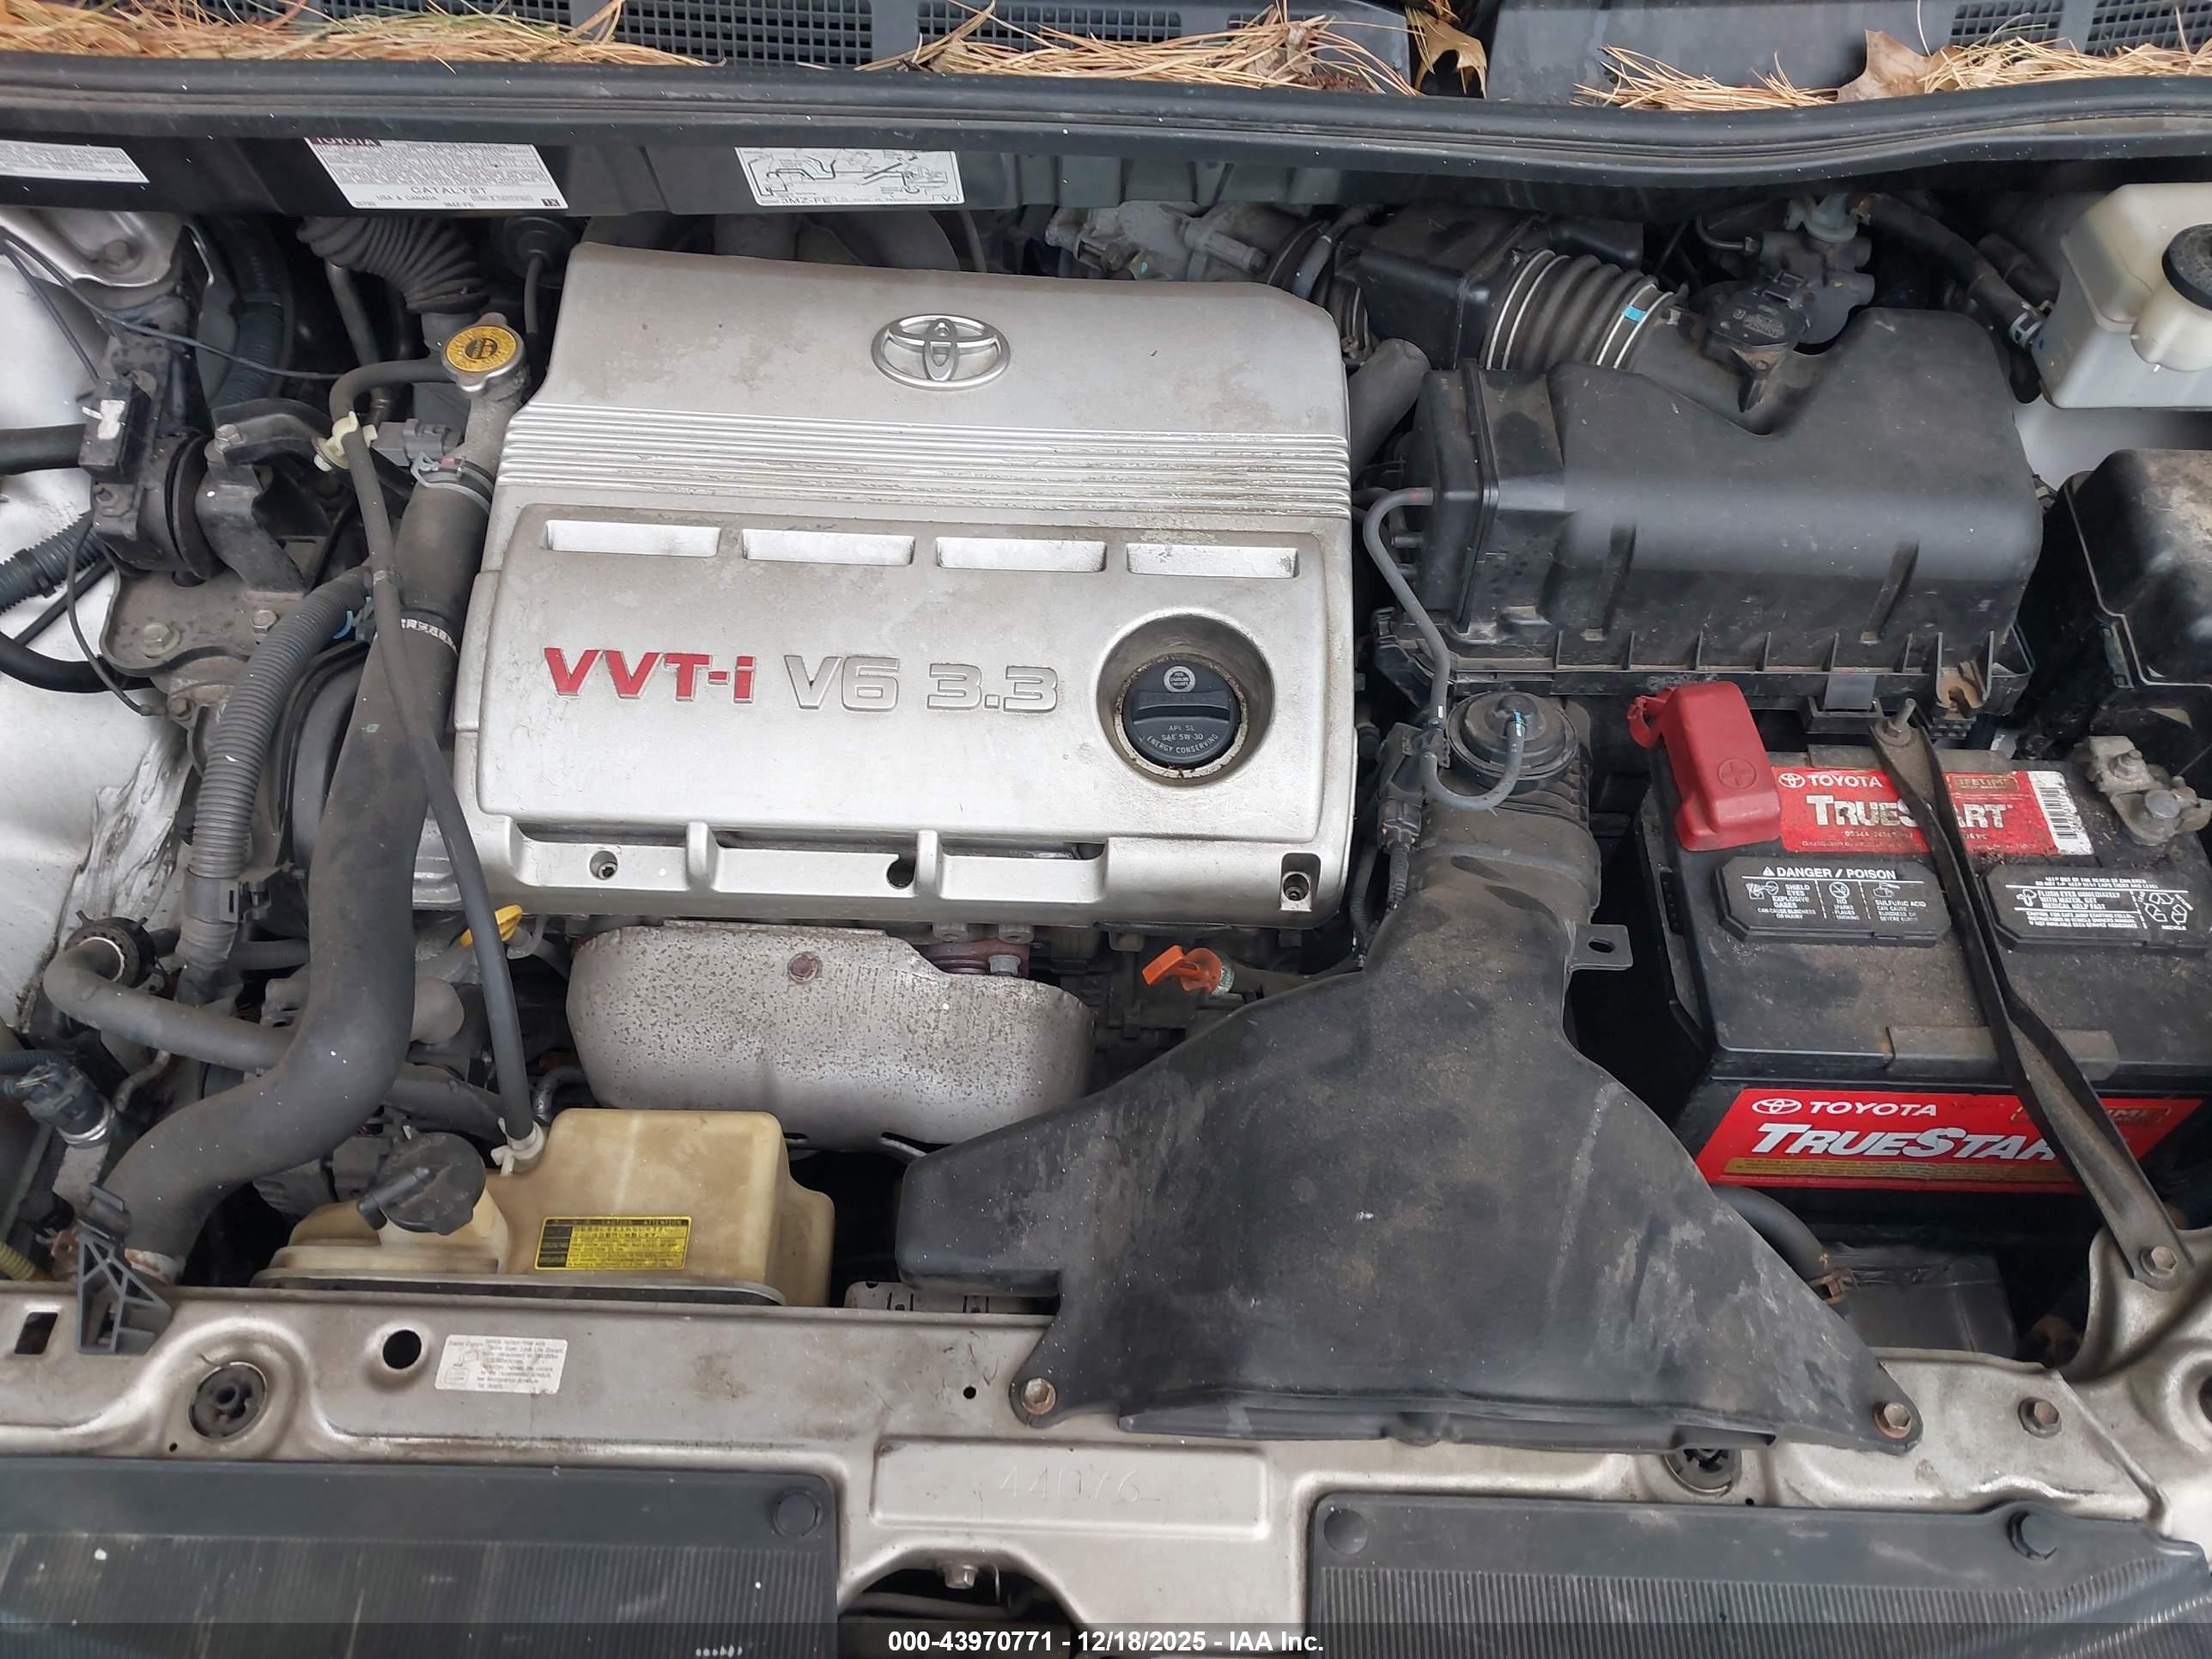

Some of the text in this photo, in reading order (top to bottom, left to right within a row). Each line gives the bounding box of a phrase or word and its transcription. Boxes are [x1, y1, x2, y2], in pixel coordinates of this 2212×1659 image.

[410, 186, 488, 195] CATALYST
[544, 647, 756, 703] VVT-i
[783, 654, 1059, 714] V6 3.3
[1146, 733, 1219, 754] ENERGY CONSERVING
[1807, 774, 1882, 787] TOYOTA
[1777, 867, 1832, 878] DANGER
[1846, 869, 1896, 879] POISON
[1809, 1101, 1937, 1117] TOYOTA
